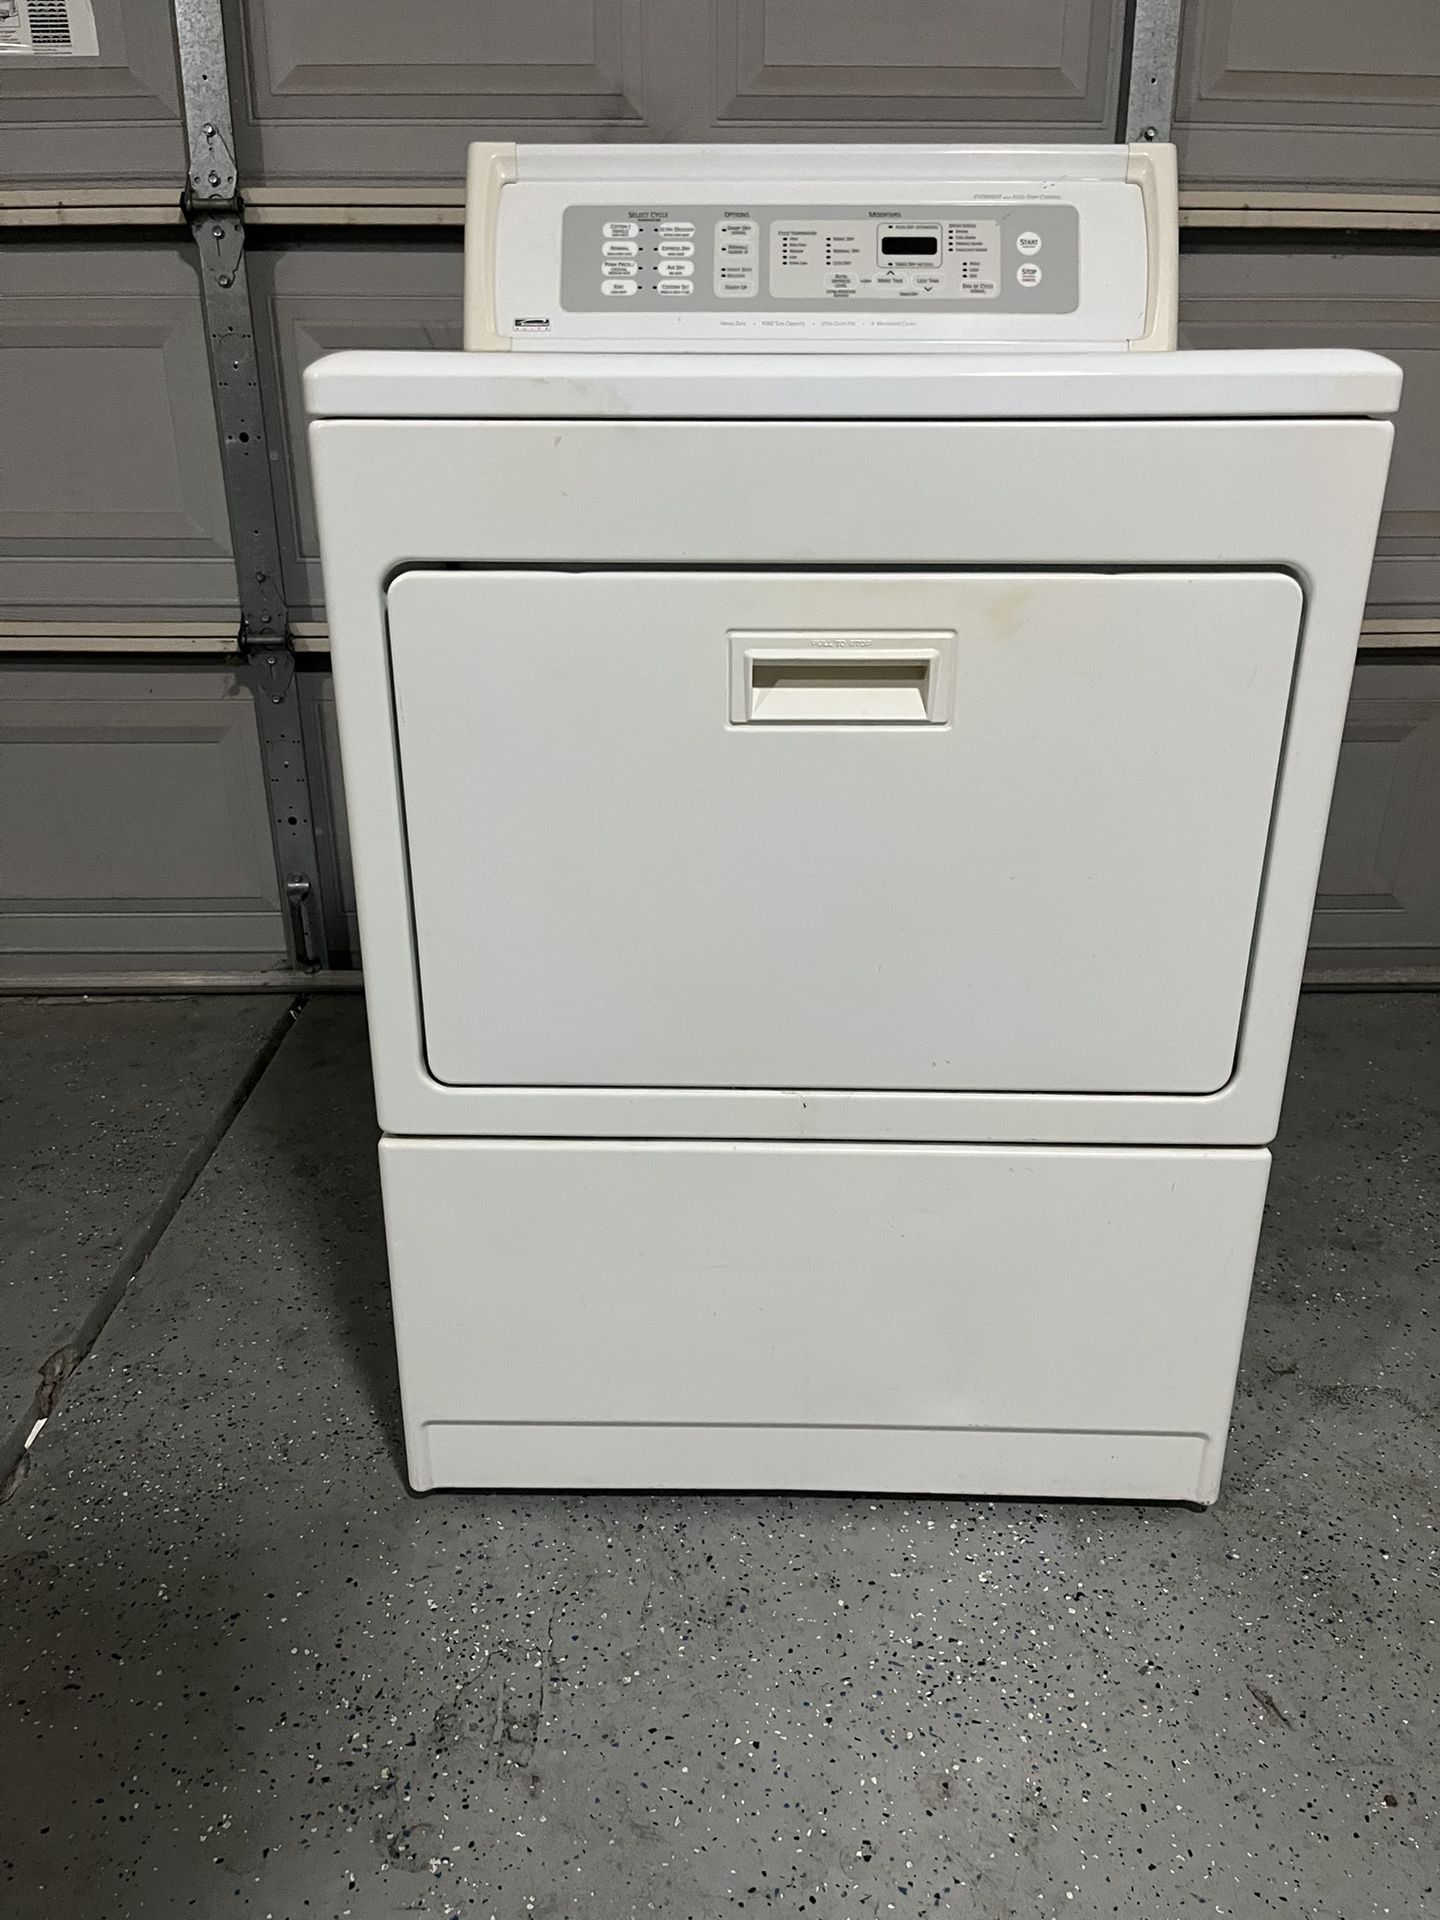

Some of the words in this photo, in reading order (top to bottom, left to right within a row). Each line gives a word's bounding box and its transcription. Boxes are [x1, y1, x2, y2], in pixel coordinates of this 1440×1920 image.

[628, 211, 649, 219] SELECT
[650, 211, 669, 219] CYCLE
[724, 211, 751, 219] OPTIONS
[1019, 238, 1039, 246] START
[811, 638, 834, 648] PULL
[834, 638, 847, 648] TO
[848, 639, 872, 648] STOP
